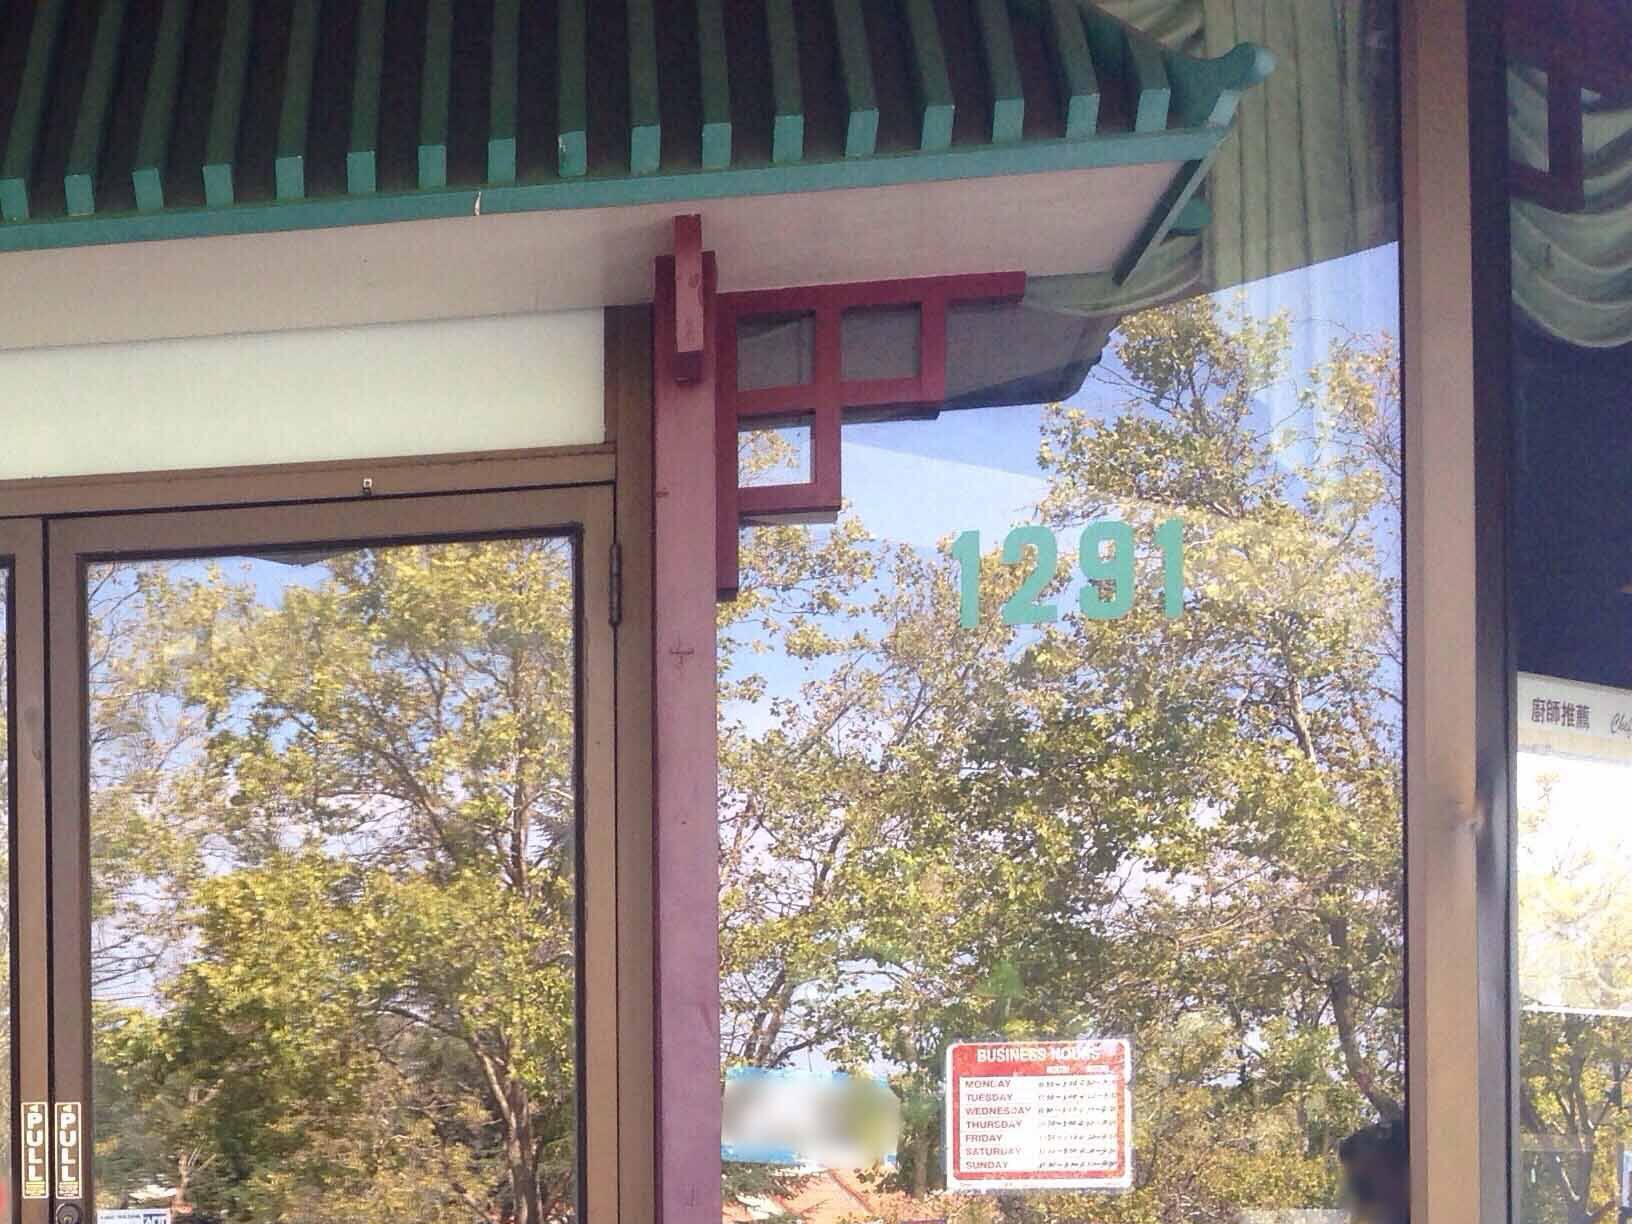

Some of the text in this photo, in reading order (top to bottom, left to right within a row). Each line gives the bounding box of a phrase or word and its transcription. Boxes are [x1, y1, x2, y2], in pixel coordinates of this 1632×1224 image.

[952, 516, 1184, 628] 1291
[975, 1047, 1046, 1063] BUSINESS
[965, 1120, 1023, 1129] THURSDAY
[965, 1134, 1003, 1142] FRIDAY
[26, 1112, 44, 1182] PULL
[58, 1112, 77, 1182] PULL
[965, 1161, 1009, 1169] SUNDAY
